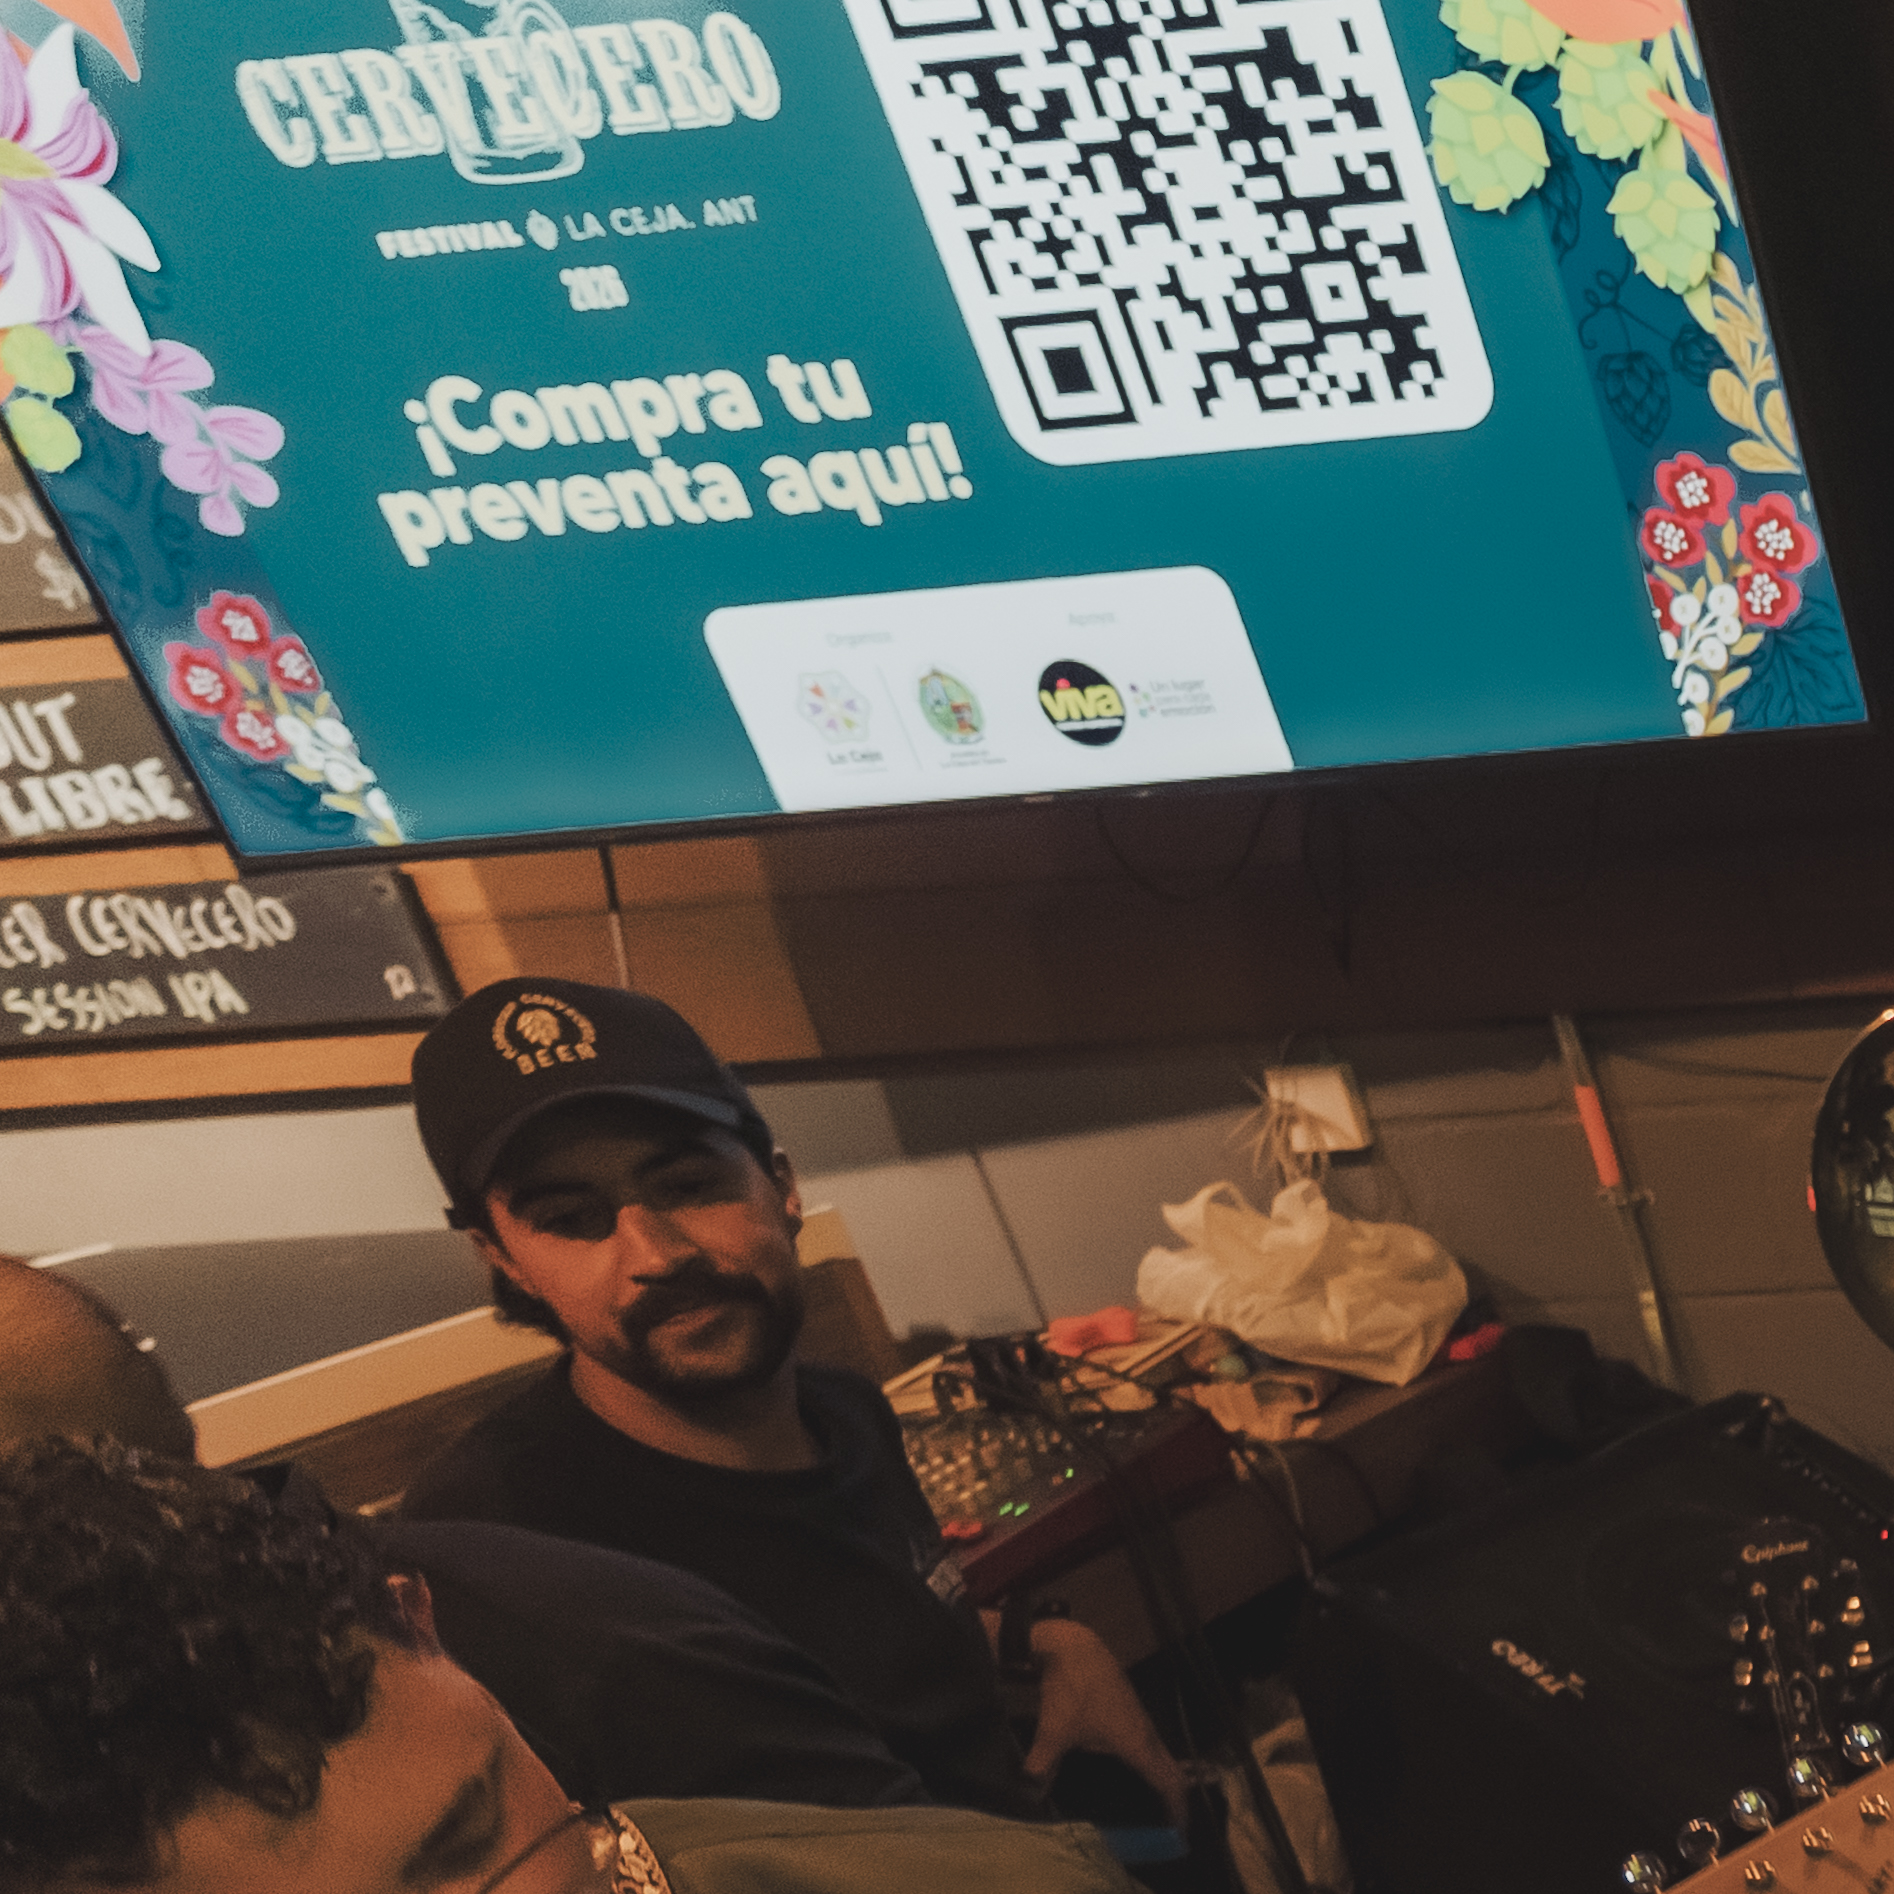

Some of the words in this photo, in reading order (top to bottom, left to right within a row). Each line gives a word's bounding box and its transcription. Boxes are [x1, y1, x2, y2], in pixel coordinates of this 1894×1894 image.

[235, 11, 782, 168] CERVECERO
[374, 219, 525, 260] FESTIVAL
[563, 212, 607, 241] LA
[702, 194, 758, 227] ANT
[402, 368, 760, 478] ¡Compra
[767, 353, 872, 425] tu
[377, 453, 752, 567] preventa
[766, 421, 975, 527] aquí!
[0, 692, 84, 772] UT
[0, 756, 192, 838] LIBRE
[66, 883, 297, 959] CERVECERO
[2, 977, 168, 1036] SESSION
[168, 968, 250, 1025] IPA
